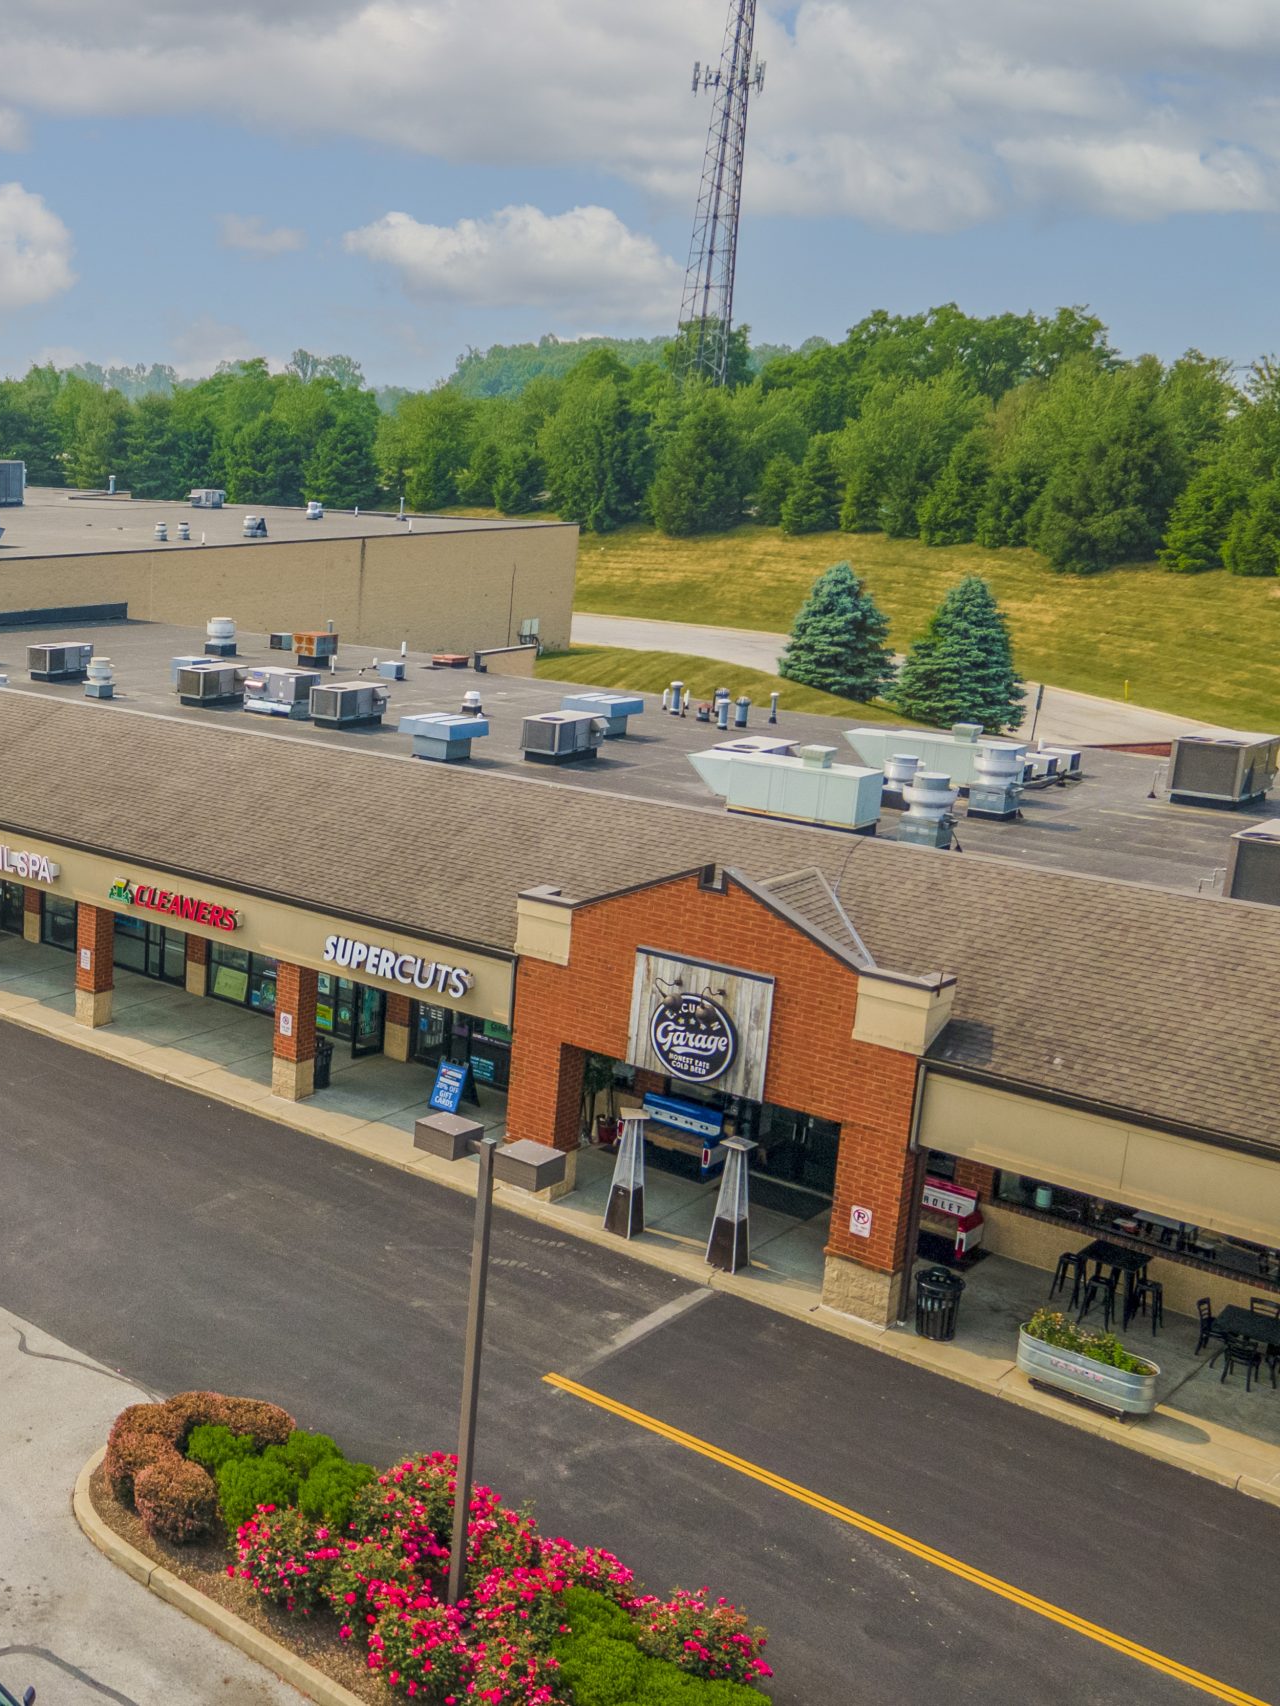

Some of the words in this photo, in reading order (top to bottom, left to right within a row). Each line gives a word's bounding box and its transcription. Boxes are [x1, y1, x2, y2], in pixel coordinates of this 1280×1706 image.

[17, 851, 53, 884] SPA
[134, 885, 236, 932] CLEANERS
[323, 935, 470, 998] SUPERCUTS
[656, 1021, 728, 1055] Garage
[668, 1052, 694, 1064] HONEST
[694, 1060, 710, 1069] EATS
[671, 1060, 689, 1070] COLD
[690, 1066, 706, 1075] BEER
[439, 1090, 453, 1099] GIFT
[449, 1085, 459, 1093] OFF
[434, 1096, 454, 1107] CARDS
[923, 1195, 962, 1213] ROLET
